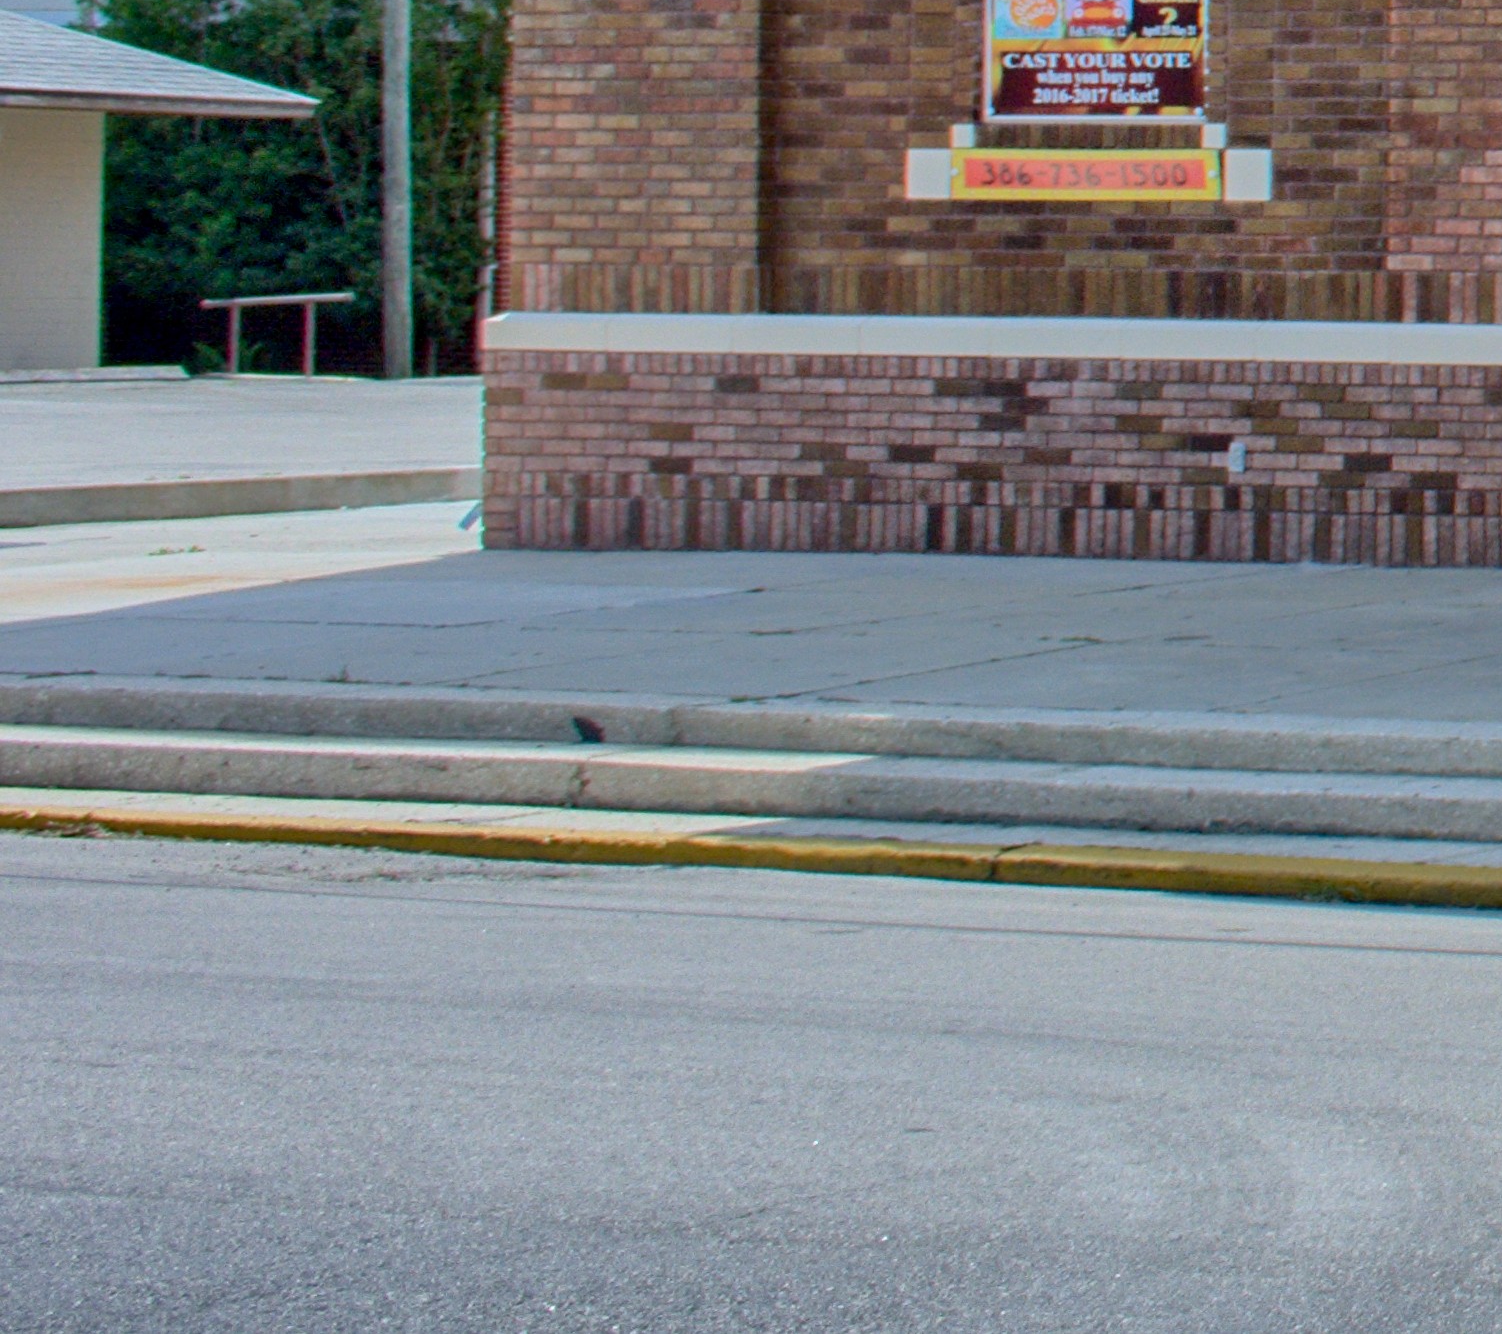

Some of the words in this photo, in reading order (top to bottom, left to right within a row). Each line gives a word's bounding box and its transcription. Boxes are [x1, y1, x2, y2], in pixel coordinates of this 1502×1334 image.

[1002, 52, 1062, 69] CAST
[1064, 52, 1126, 69] YOUR
[1130, 51, 1192, 69] VOTE
[1074, 72, 1100, 88] you
[1129, 72, 1156, 88] any
[1032, 87, 1108, 104] 2016-2017
[981, 161, 1188, 187] 386-736-1500
